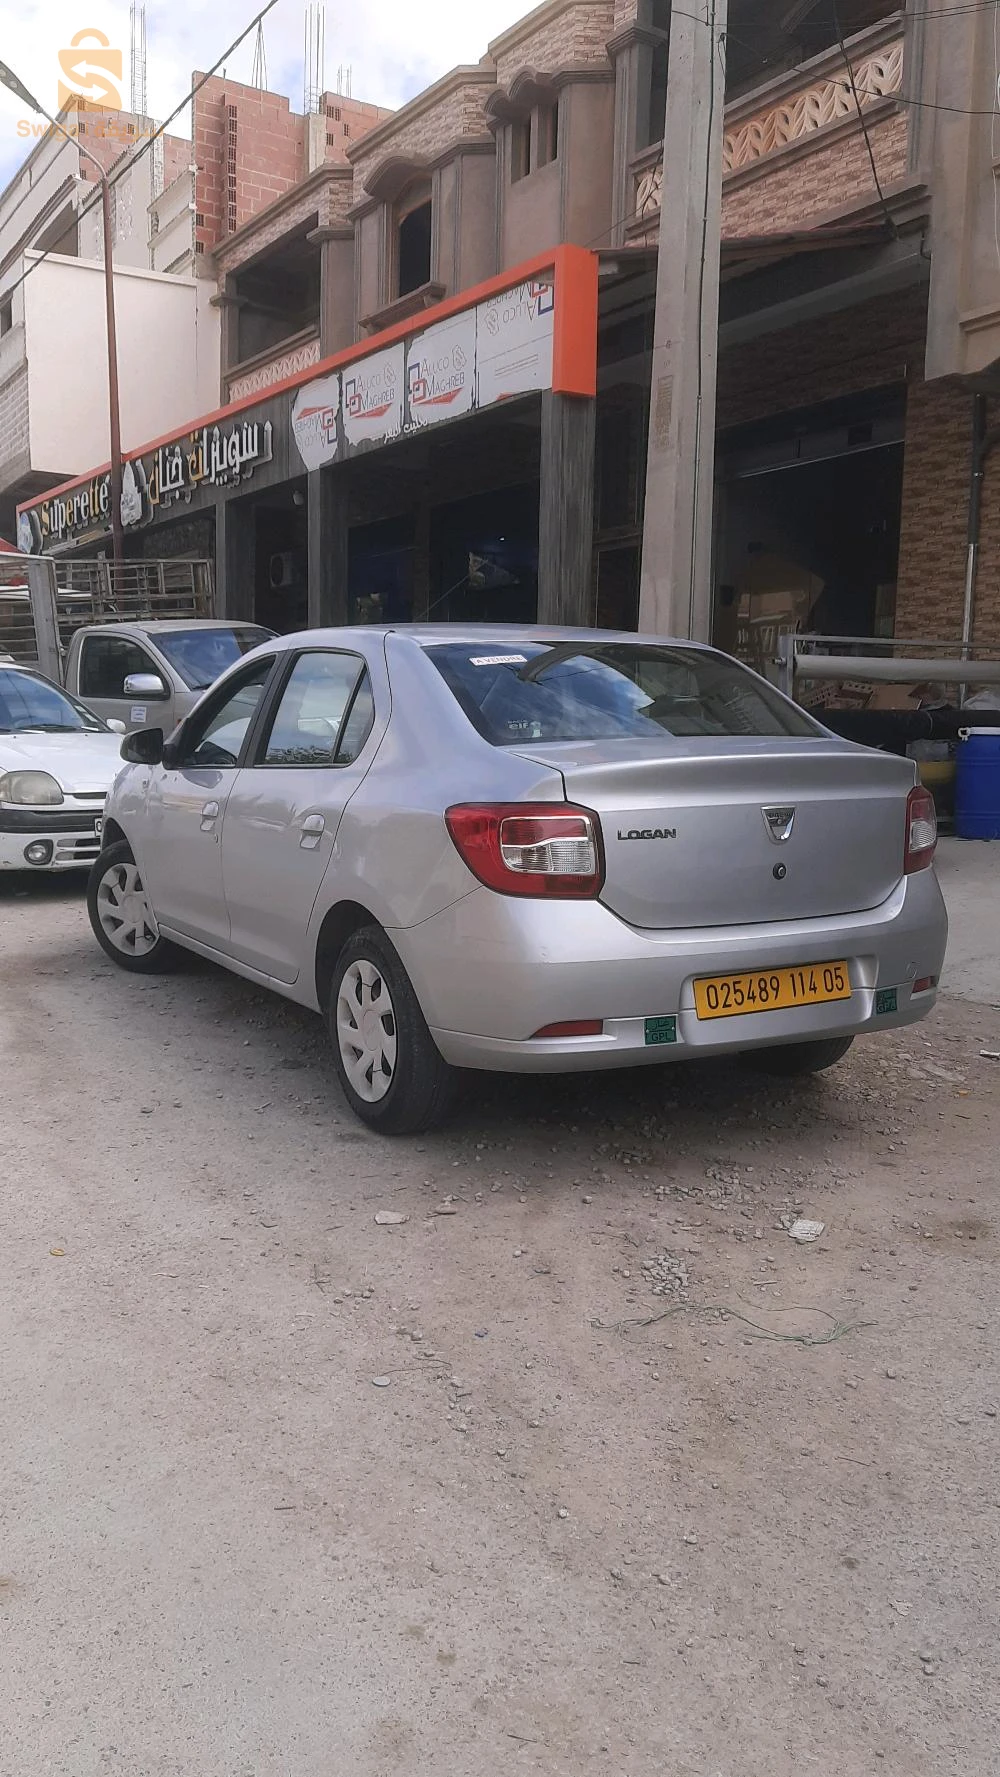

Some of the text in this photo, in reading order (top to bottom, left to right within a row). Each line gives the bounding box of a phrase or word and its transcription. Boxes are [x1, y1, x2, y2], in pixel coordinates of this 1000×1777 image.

[617, 828, 677, 840] LOGAN
[705, 966, 844, 1010] 025489 114 05
[651, 1031, 672, 1042] GPL
